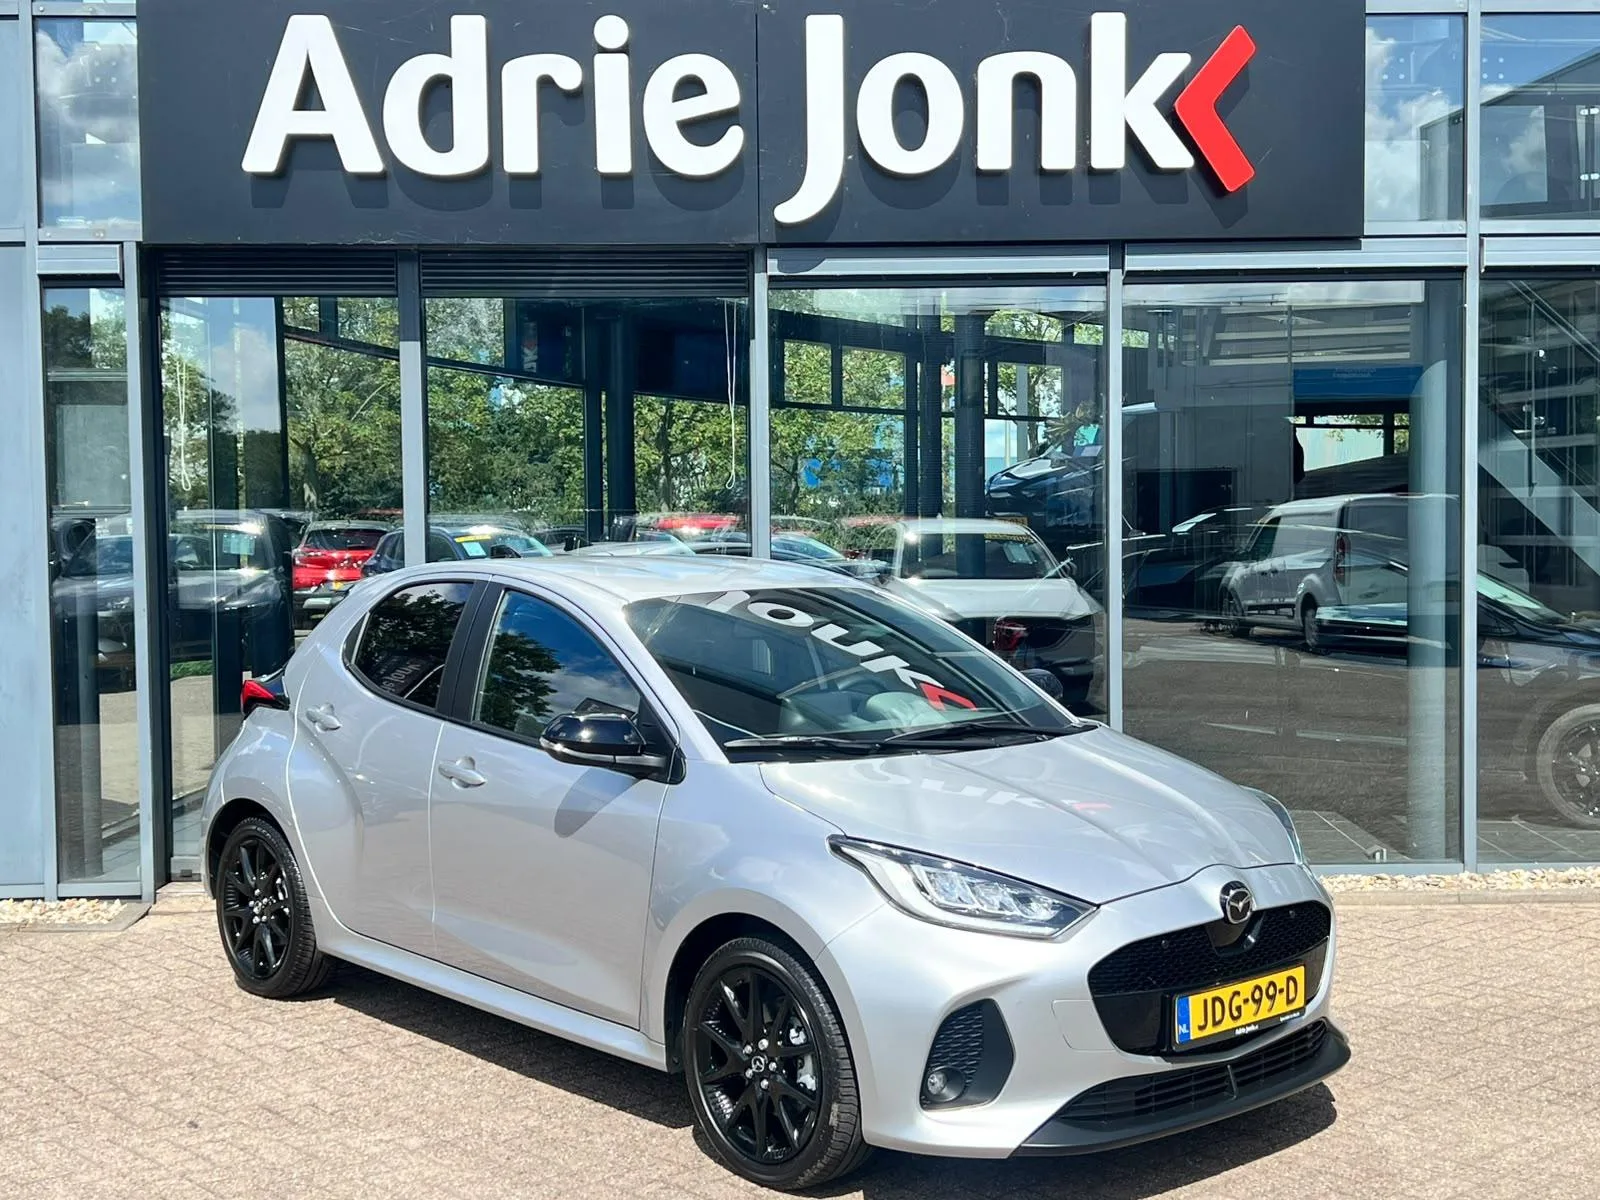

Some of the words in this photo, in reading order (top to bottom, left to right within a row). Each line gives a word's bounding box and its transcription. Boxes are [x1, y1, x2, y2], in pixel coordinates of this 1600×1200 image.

[241, 14, 744, 178] Adrie
[774, 12, 1195, 226] Jonk
[1178, 1023, 1190, 1035] NL
[1197, 975, 1298, 1032] JDG-99-D
